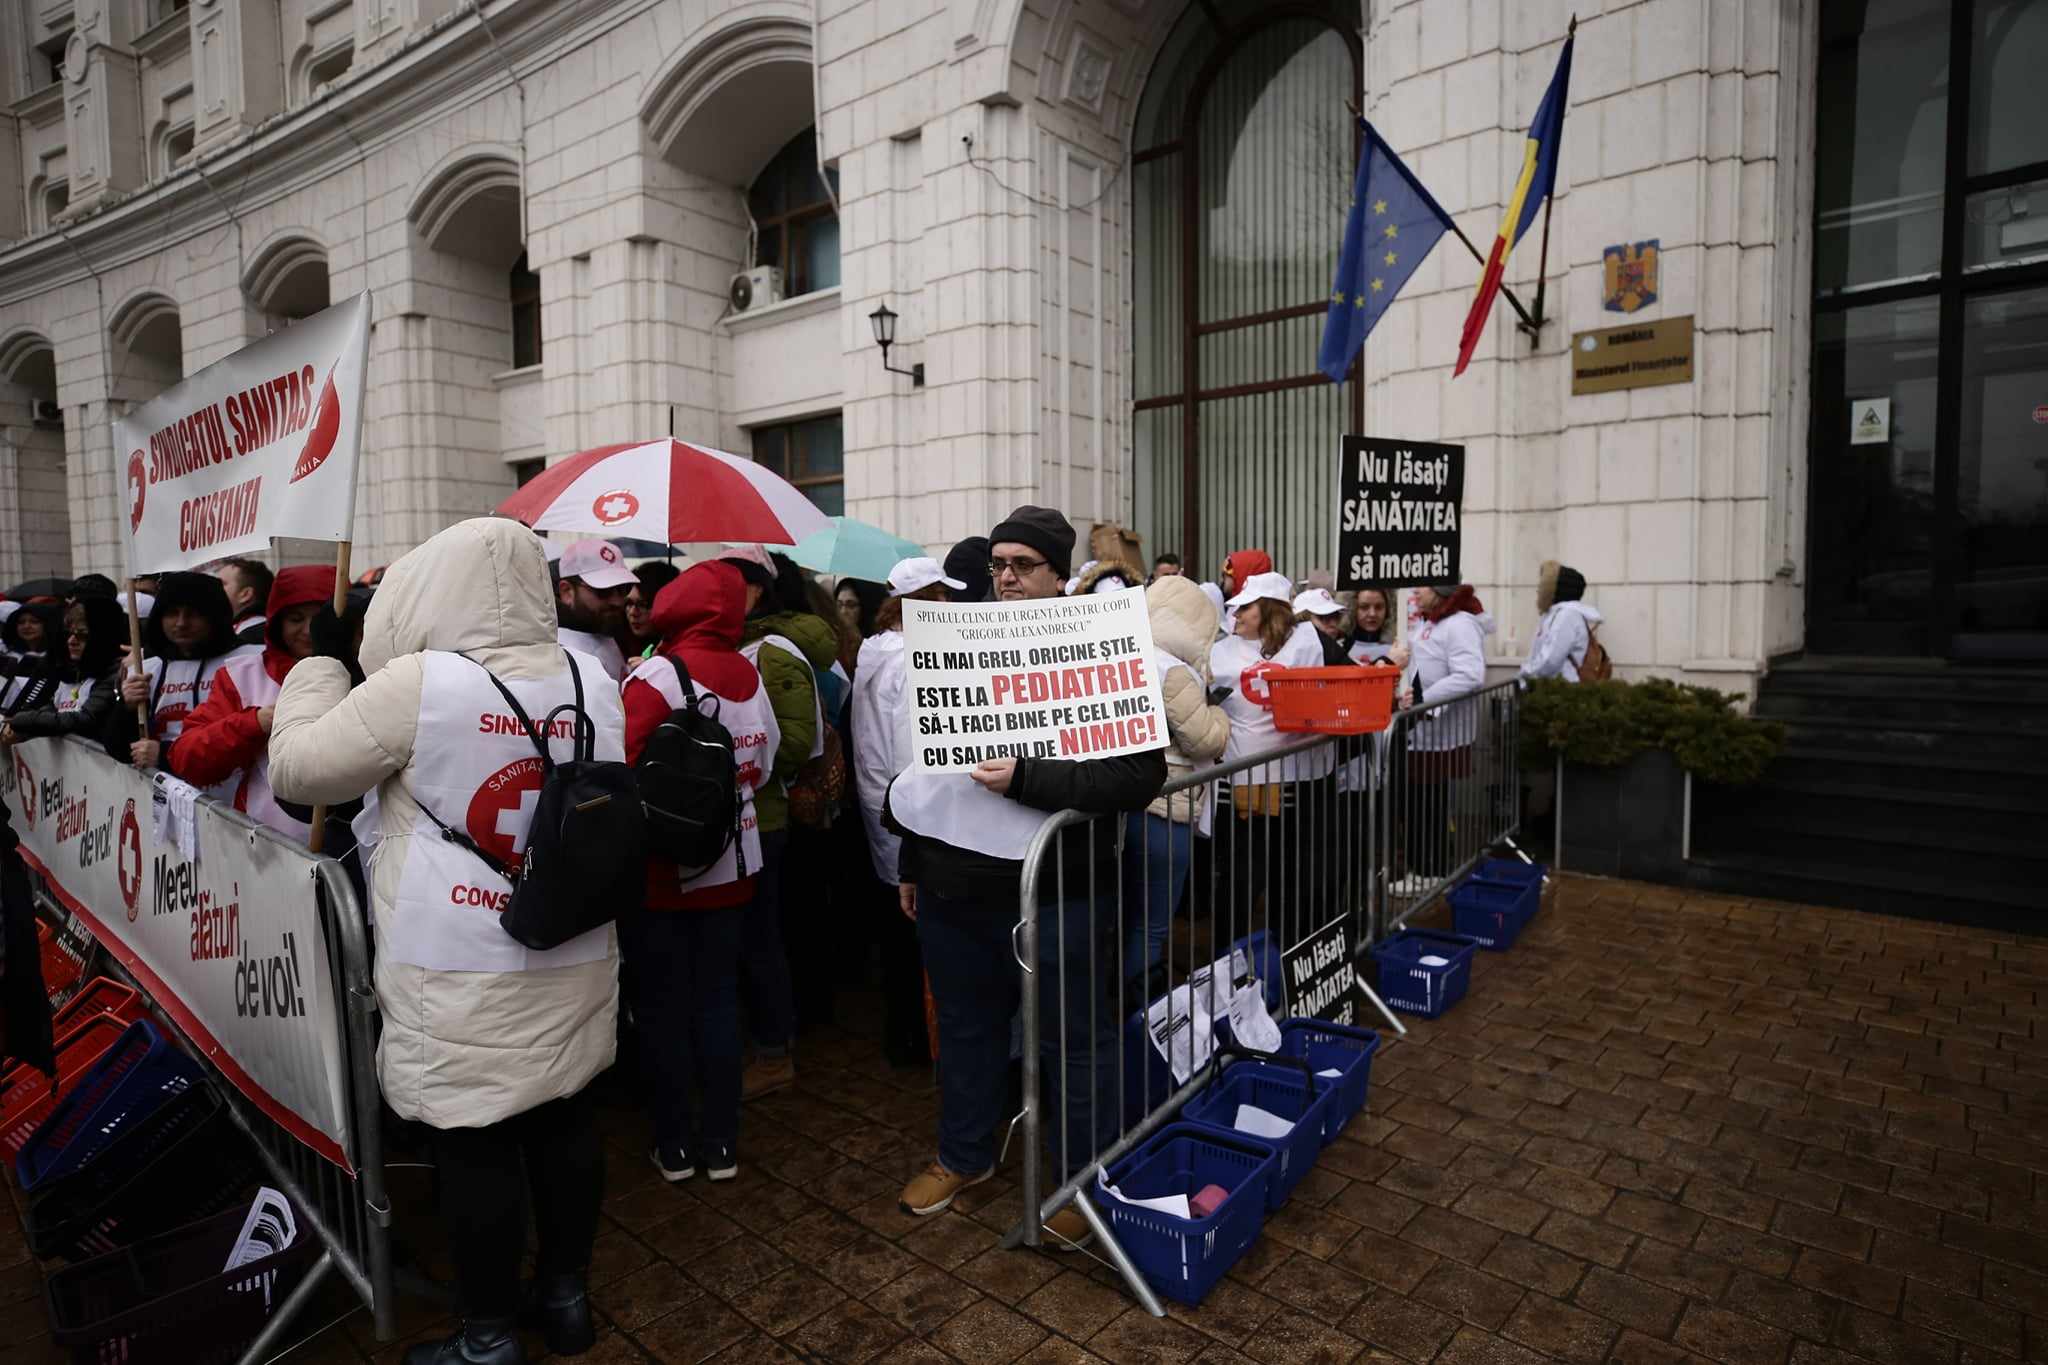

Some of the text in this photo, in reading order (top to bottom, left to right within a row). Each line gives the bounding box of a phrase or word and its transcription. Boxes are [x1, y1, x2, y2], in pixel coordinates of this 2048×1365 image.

[150, 364, 315, 485] SINDICATUL SANITAS
[1358, 450, 1389, 483] Nu
[1343, 490, 1456, 531] SĂNĂTATEA
[1350, 544, 1449, 580] să moară!
[917, 610, 960, 624] SPITALUL
[962, 611, 996, 624] CLINIC
[998, 610, 1011, 623] DE
[1062, 602, 1101, 617] PENTRU
[1103, 598, 1131, 612] COPII
[913, 636, 1141, 670] CEL MAI GREU, ORICINE ȘTIE,
[916, 658, 1148, 708] ESTE LA PEDIATRIE
[919, 713, 958, 735] SĂ-L
[962, 713, 1001, 734] FACI
[1006, 710, 1048, 731] BINE
[1052, 707, 1074, 727] PE
[1078, 702, 1111, 723] CEL
[922, 747, 949, 767] CU
[1033, 739, 1057, 759] DE
[1059, 715, 1158, 756] NIMIC!
[153, 853, 198, 916] Mereu
[190, 882, 240, 962] alături
[235, 932, 306, 1018] de voi!
[1290, 961, 1355, 1018] SĂNĂTATEA
[1293, 956, 1313, 987] Nu
